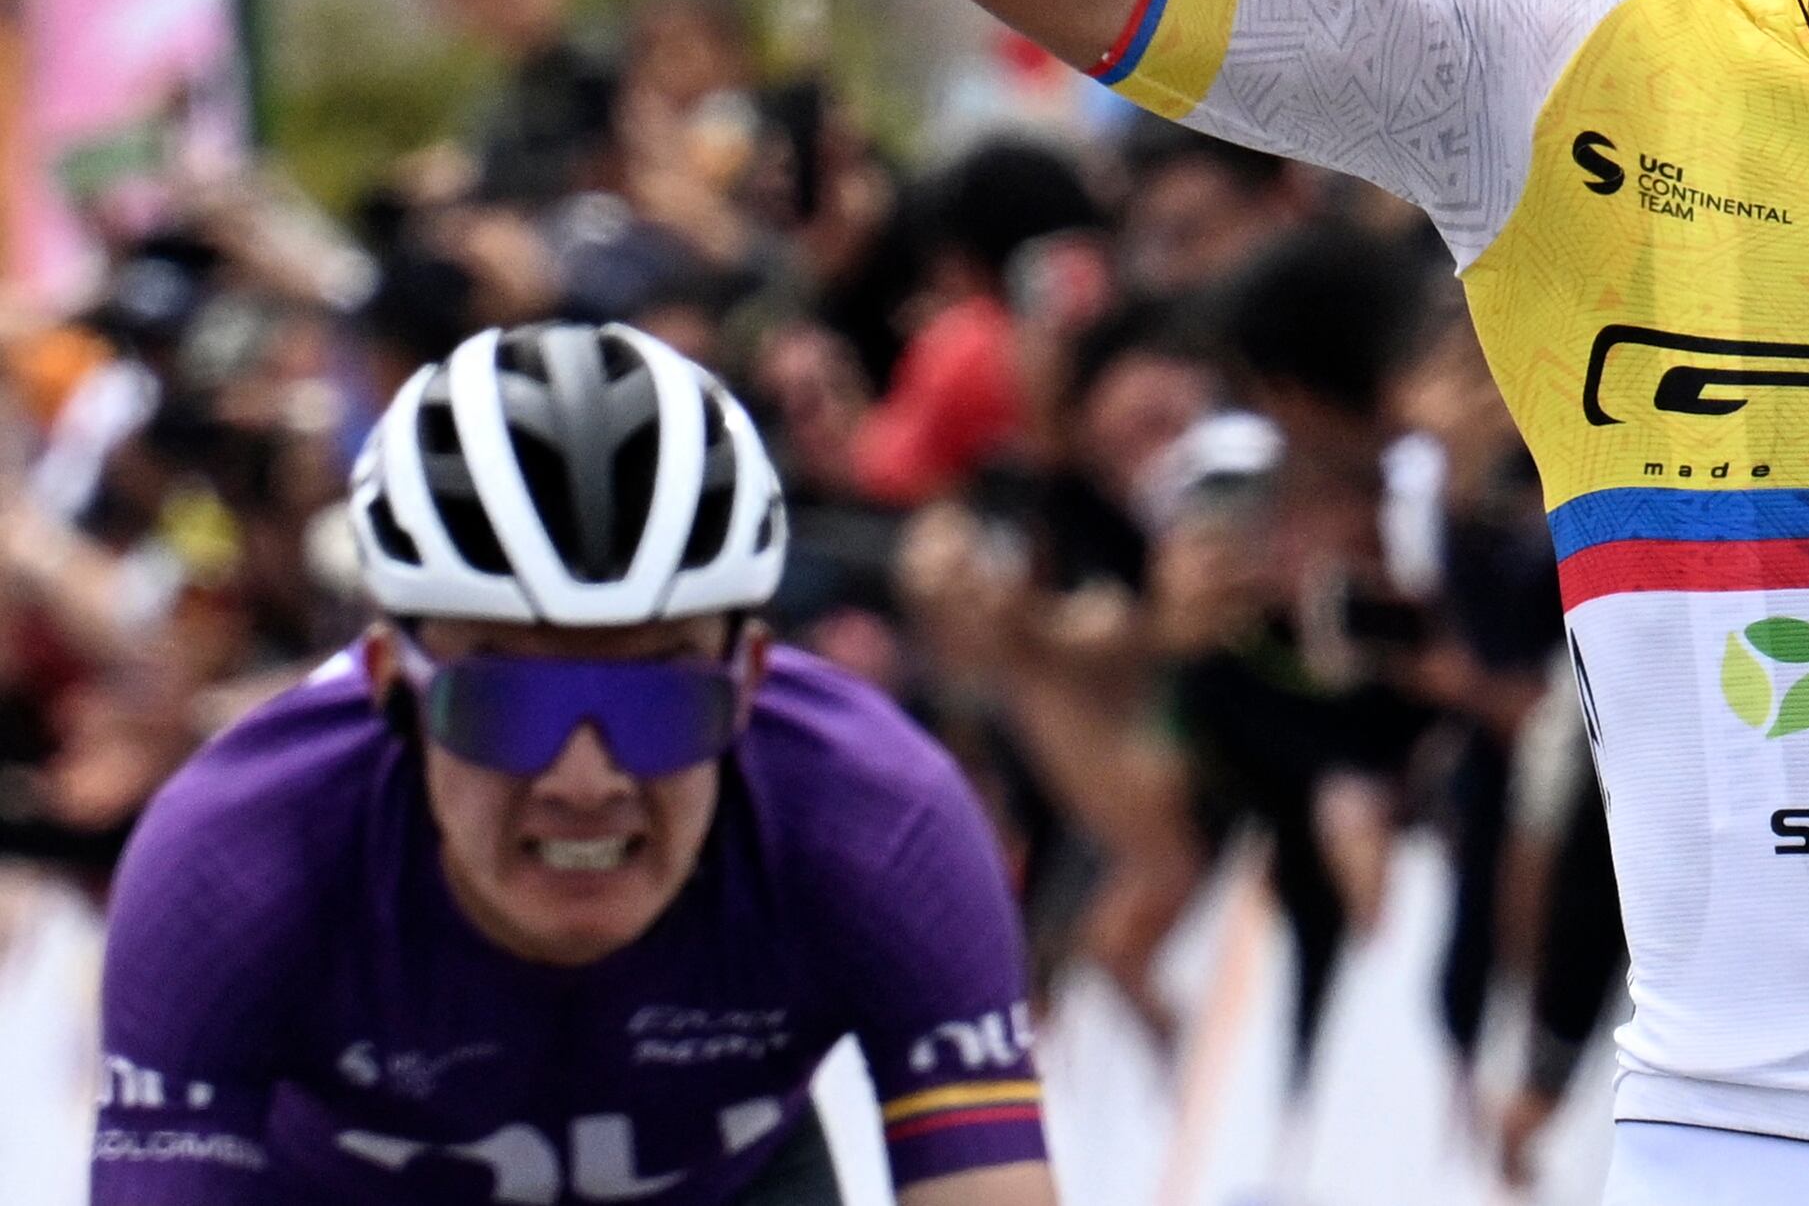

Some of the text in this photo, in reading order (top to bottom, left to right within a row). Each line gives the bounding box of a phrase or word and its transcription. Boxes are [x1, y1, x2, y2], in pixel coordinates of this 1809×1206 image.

[1639, 153, 1684, 183] UCI
[1637, 173, 1794, 225] CONTINENTAL
[1638, 190, 1695, 222] TEAM
[1643, 462, 1771, 478] made
